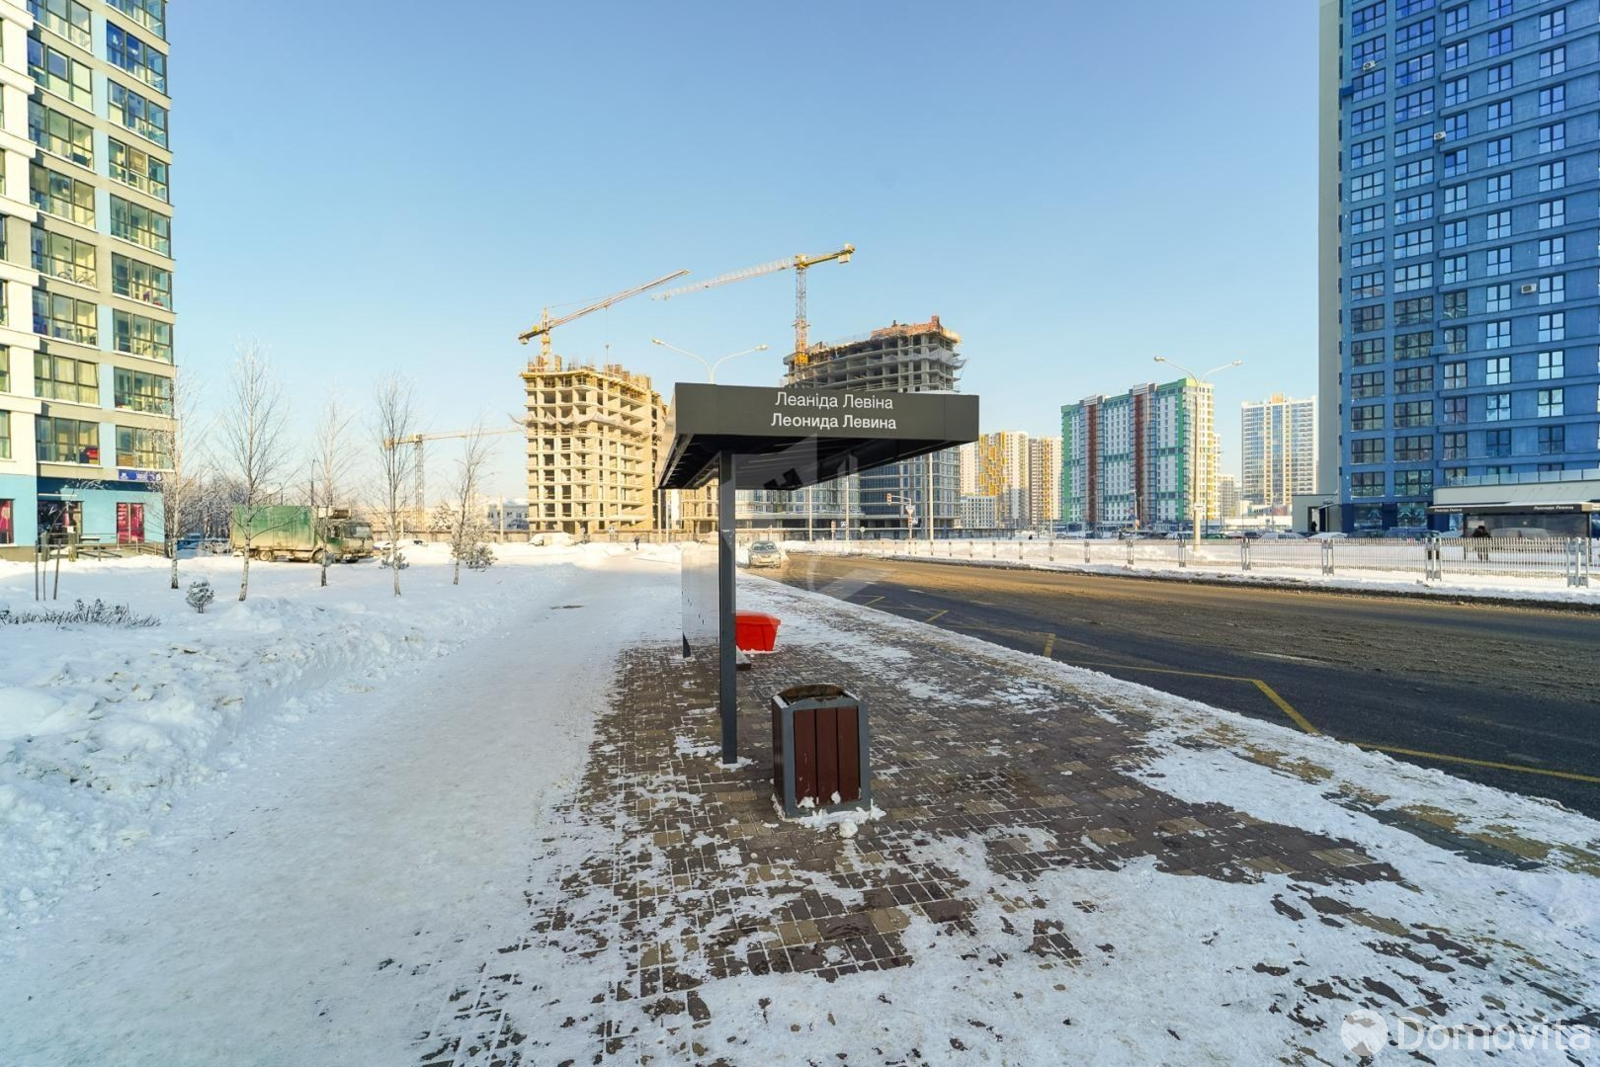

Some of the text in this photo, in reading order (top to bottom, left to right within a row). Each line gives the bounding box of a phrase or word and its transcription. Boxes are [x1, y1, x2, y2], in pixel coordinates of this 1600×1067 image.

[775, 391, 893, 409] Леаніда Левіна
[771, 412, 897, 430] Леонида Левина
